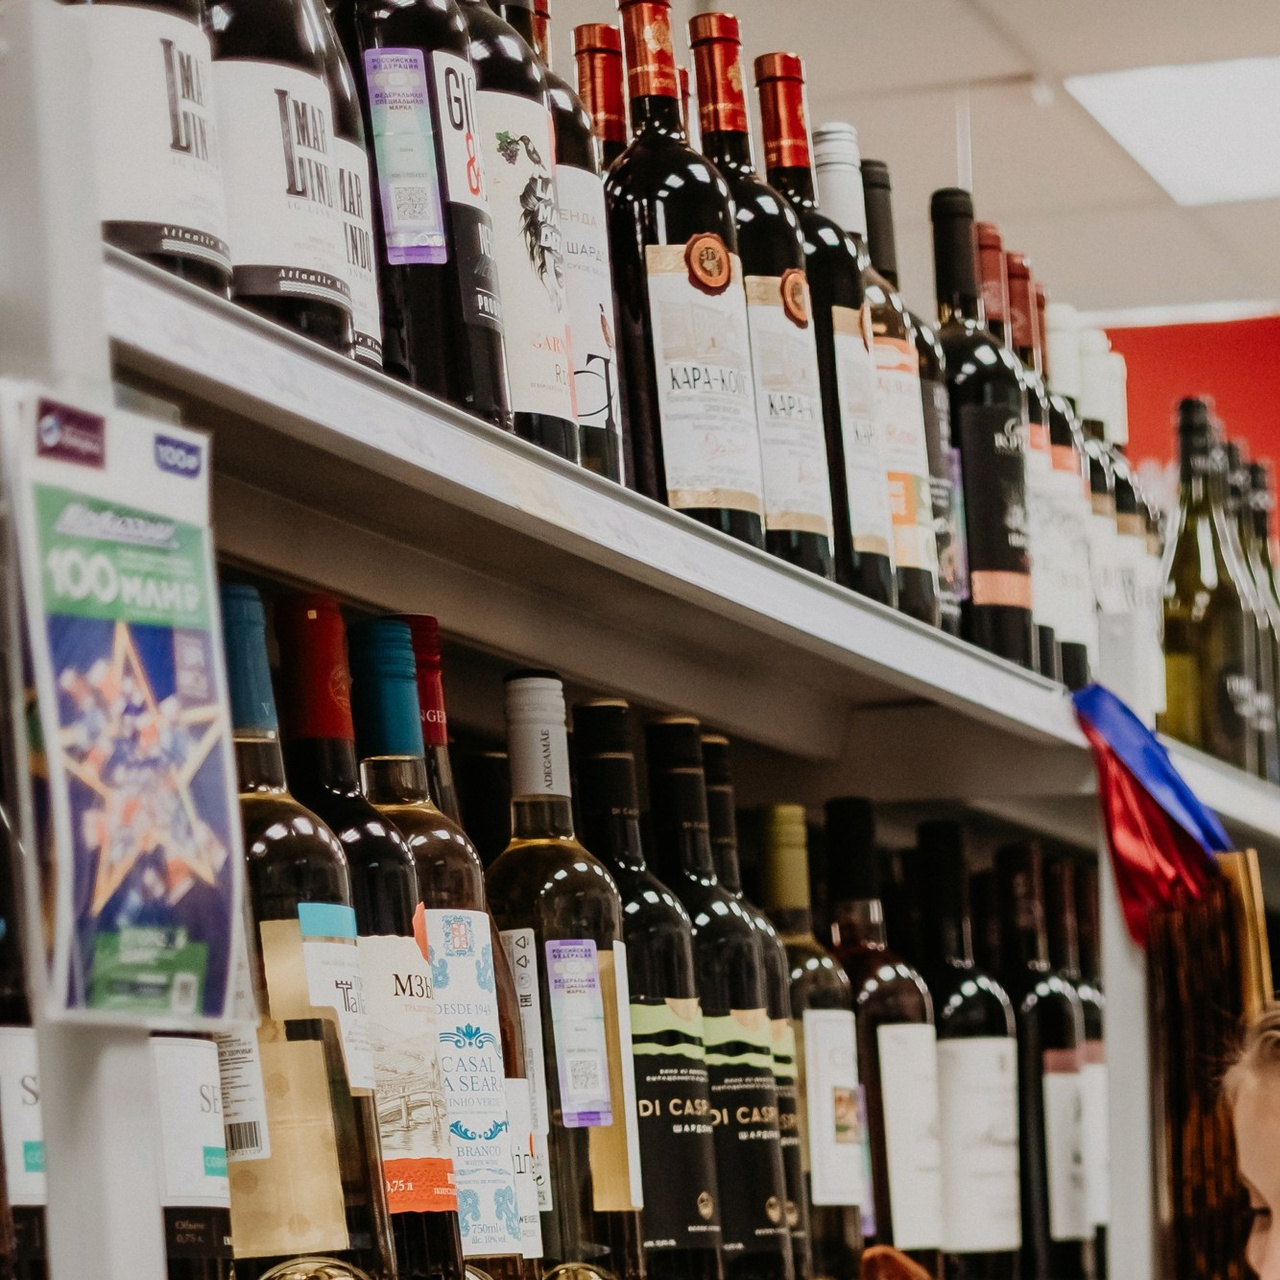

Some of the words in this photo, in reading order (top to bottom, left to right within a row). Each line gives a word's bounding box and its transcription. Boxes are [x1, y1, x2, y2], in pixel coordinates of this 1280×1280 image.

[344, 221, 373, 273] INDO
[279, 268, 332, 285] Atlantic
[336, 281, 350, 295] Win
[442, 1056, 496, 1074] CASAL
[638, 1099, 661, 1118] DI
[456, 1146, 501, 1158] BRANCO
